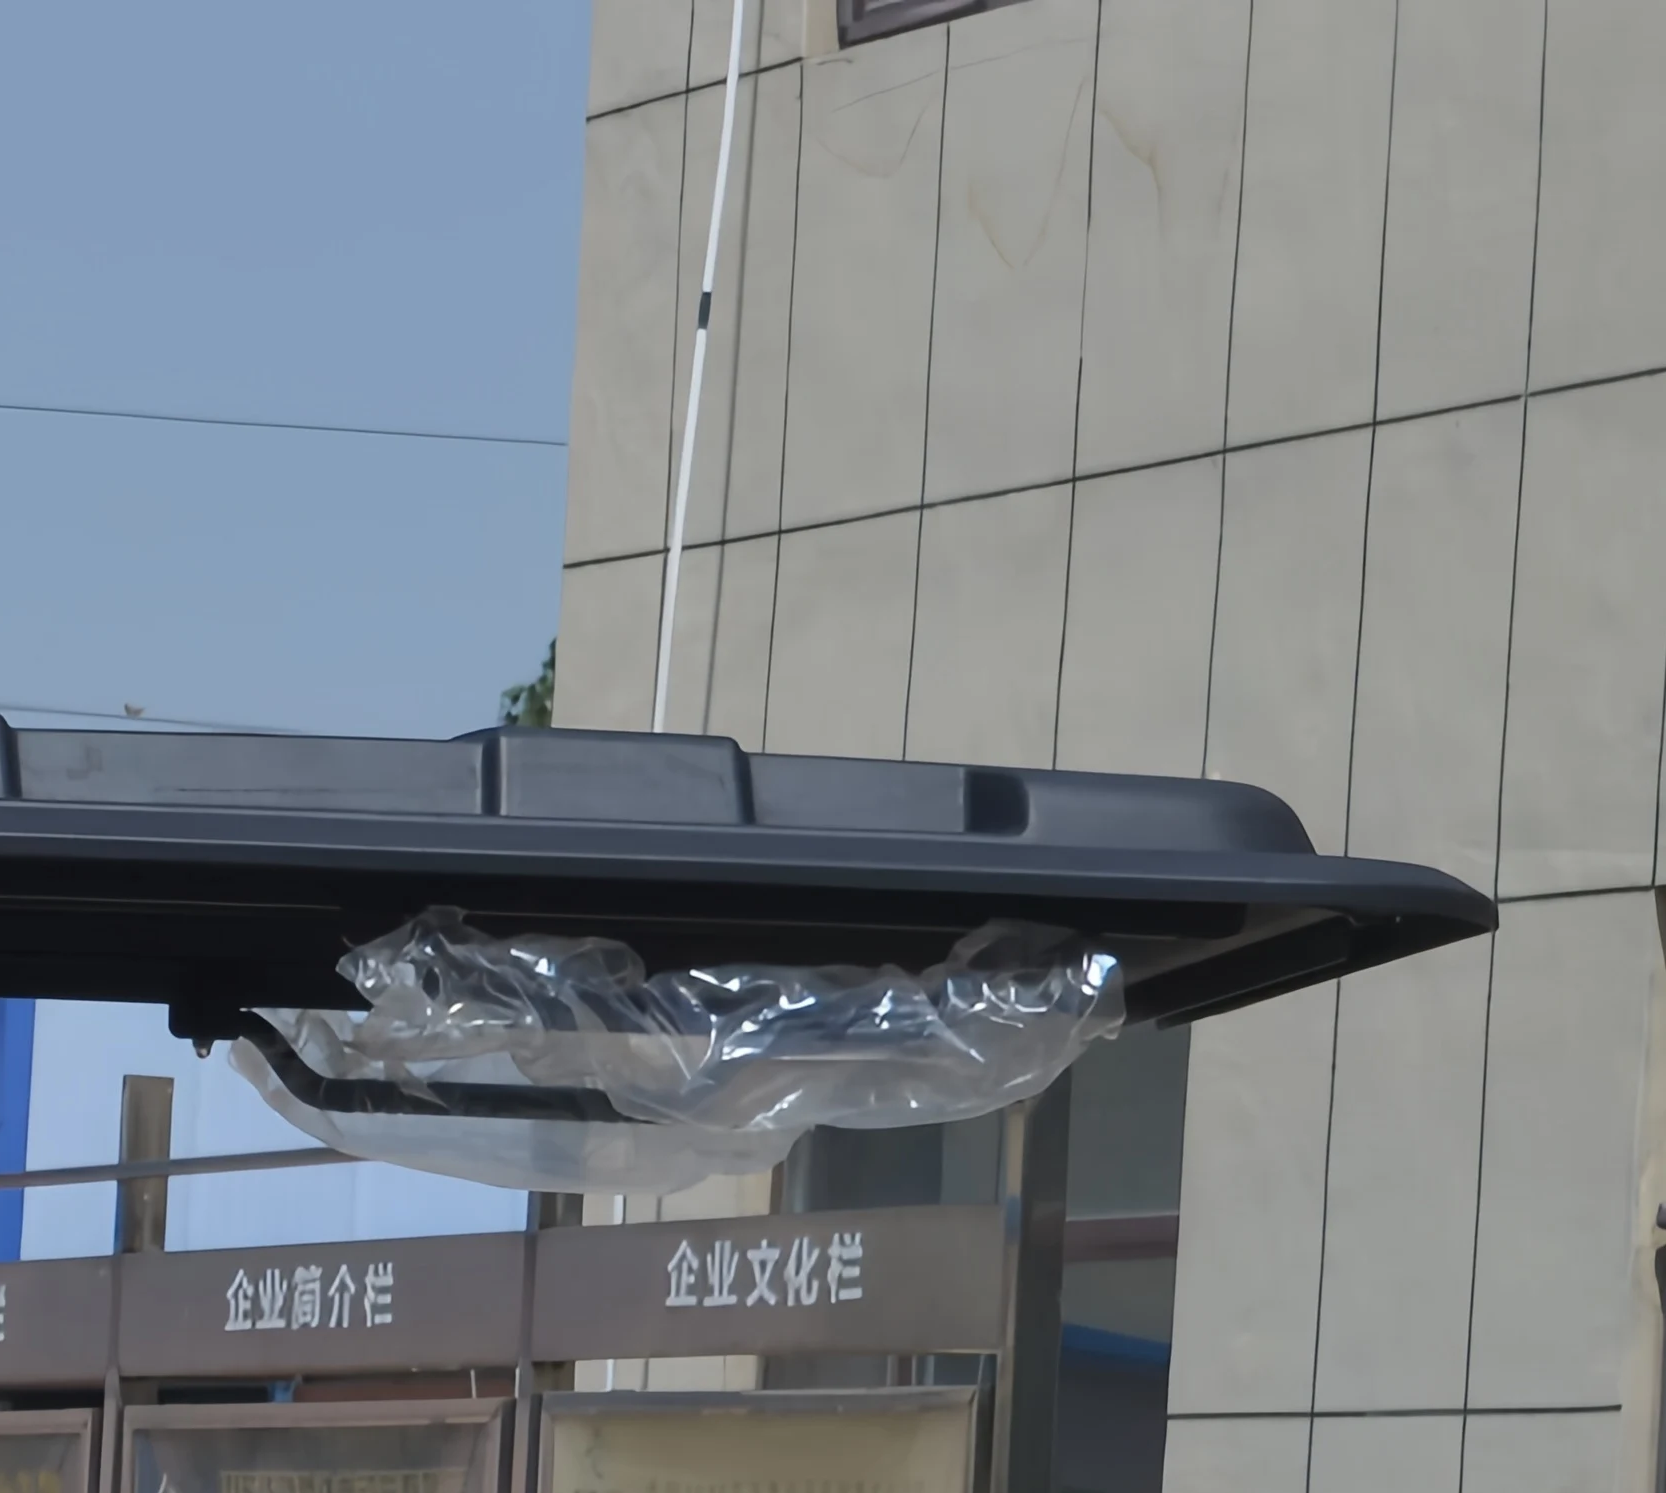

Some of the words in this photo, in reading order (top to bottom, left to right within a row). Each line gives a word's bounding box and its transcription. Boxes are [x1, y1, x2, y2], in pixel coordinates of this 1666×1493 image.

[223, 1261, 395, 1332] 企业简介栏
[665, 1231, 864, 1310] 企业文化栏
